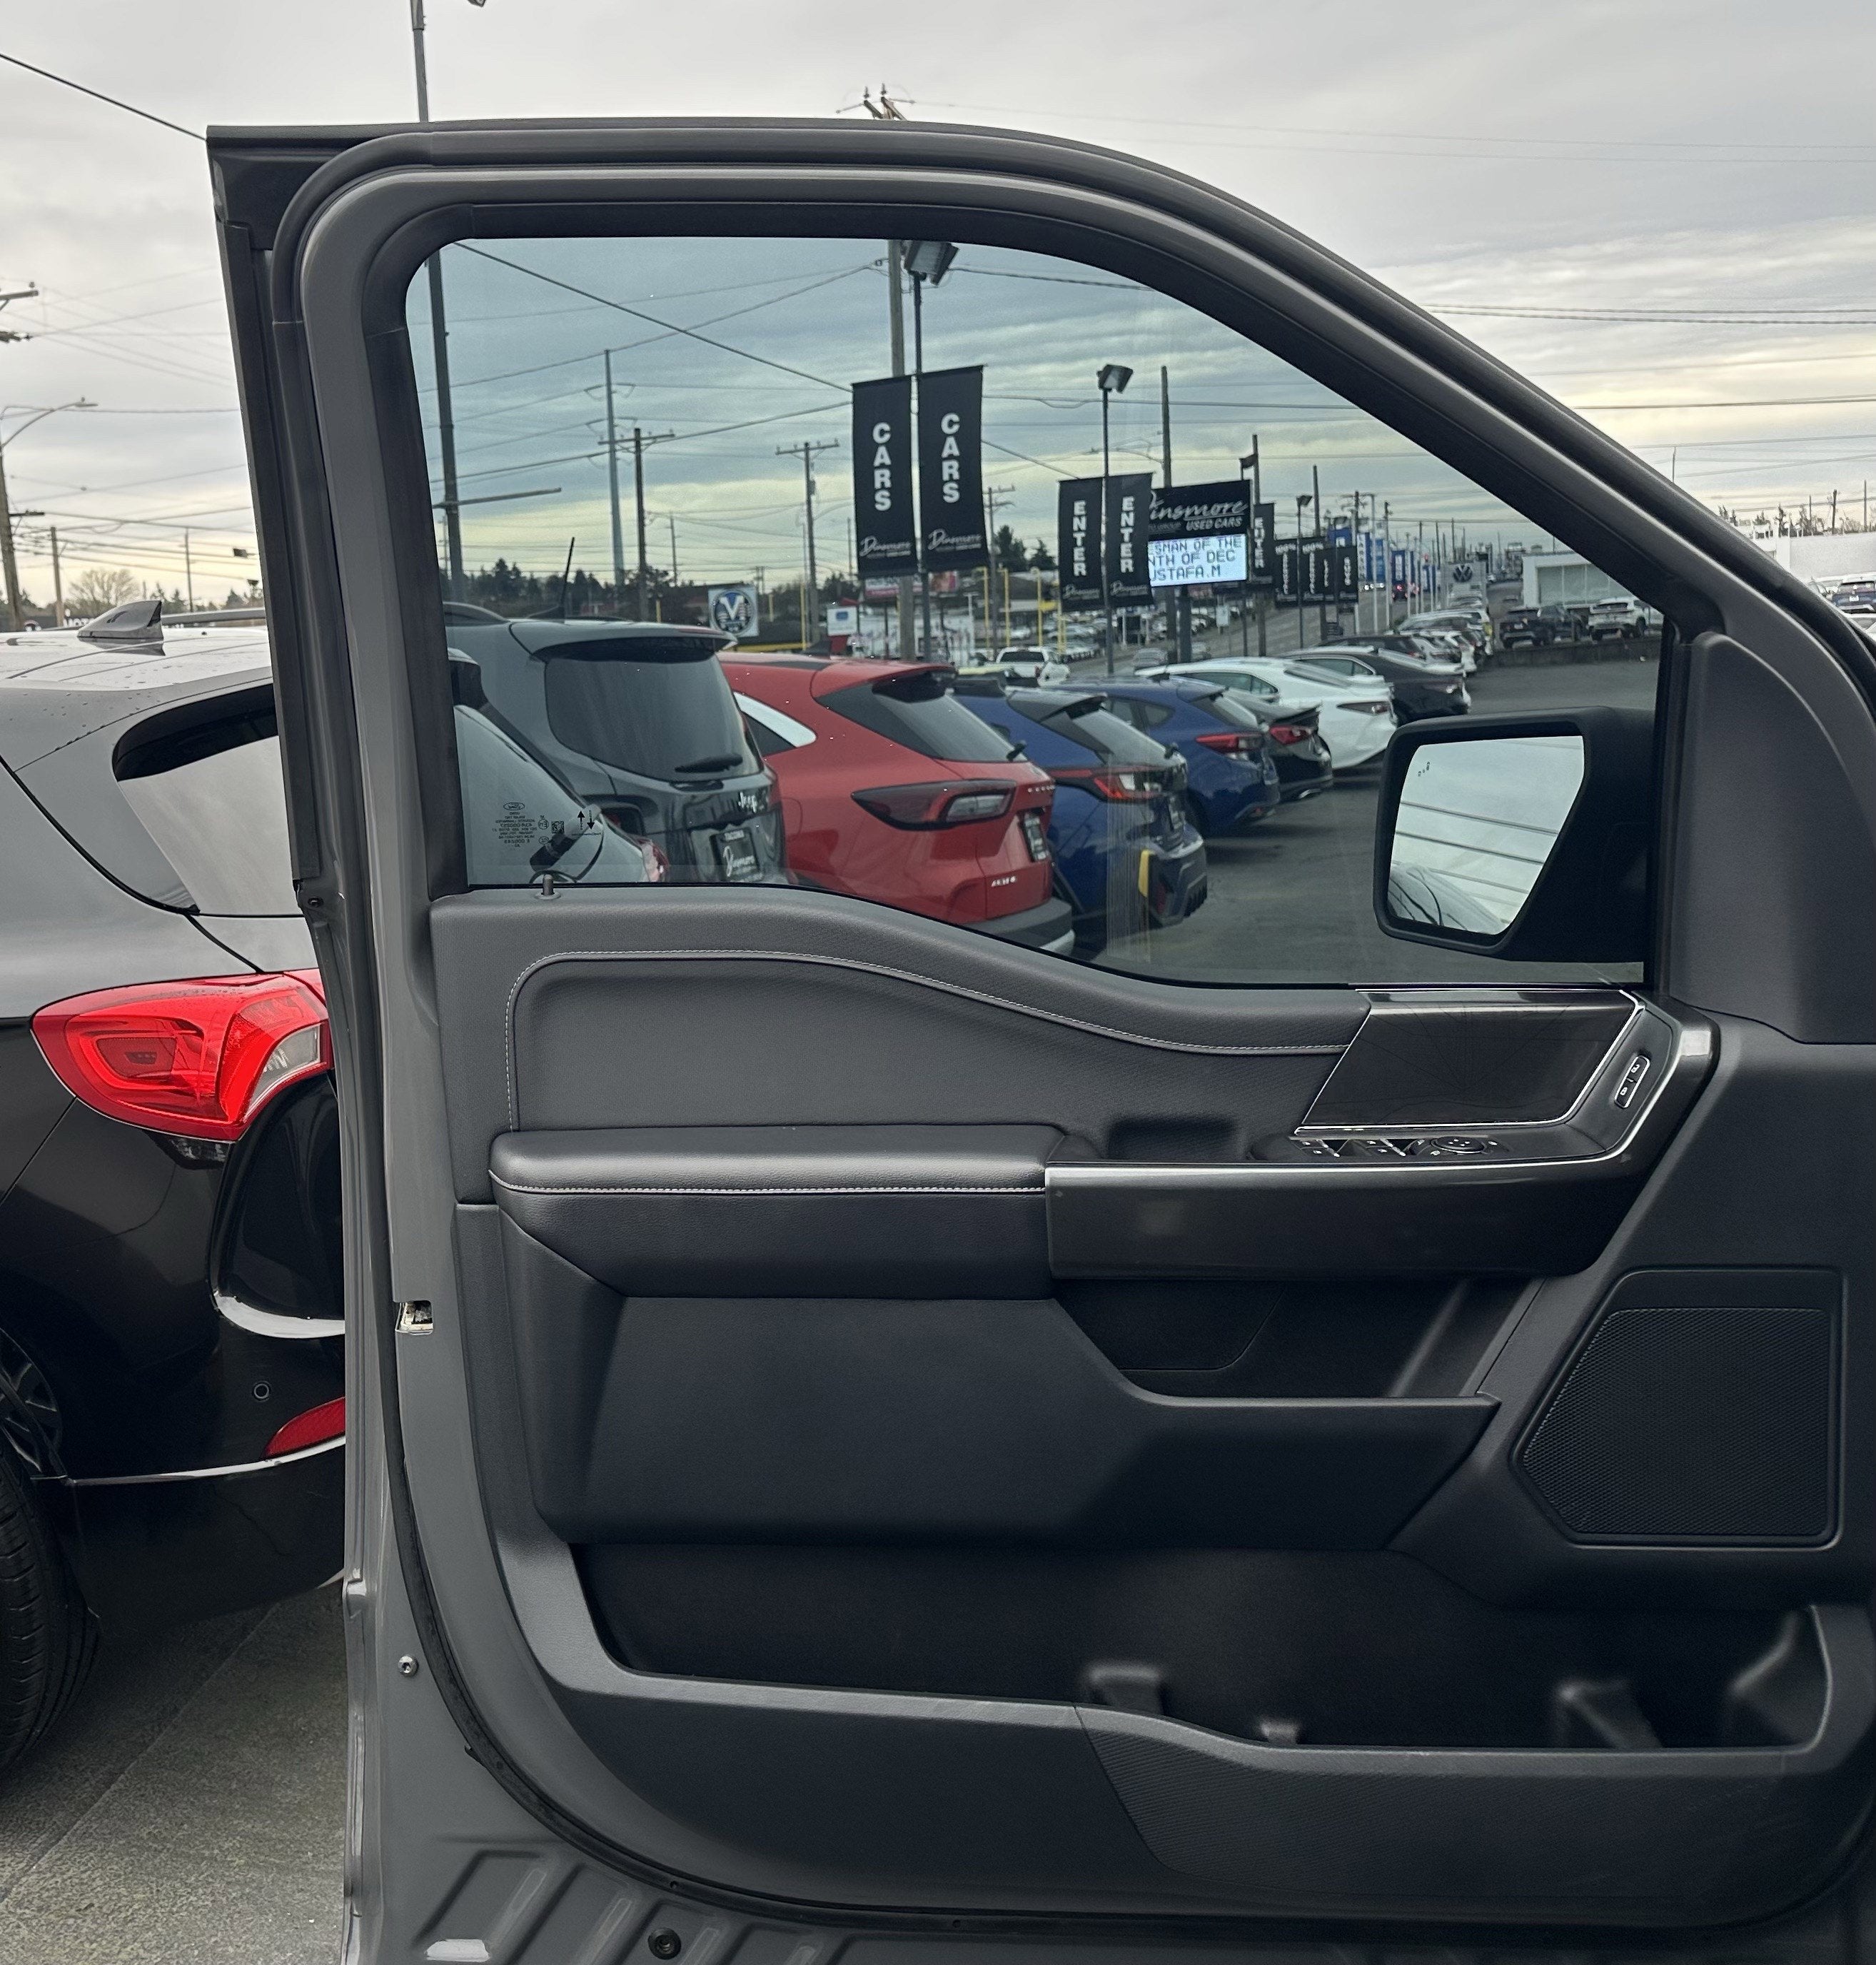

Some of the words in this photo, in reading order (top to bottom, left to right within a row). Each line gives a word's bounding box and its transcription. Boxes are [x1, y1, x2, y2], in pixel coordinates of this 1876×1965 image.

[872, 422, 892, 511] CARS
[941, 412, 961, 503] CARS
[1072, 500, 1087, 577] ENTER
[1120, 496, 1135, 573] ENTER
[1186, 518, 1214, 531] USED
[1214, 516, 1243, 529] CARS
[1194, 538, 1211, 552] OF
[1216, 534, 1243, 549] THE
[1254, 516, 1266, 569] ENTER
[1181, 551, 1200, 566] OF
[1206, 548, 1236, 564] DEC
